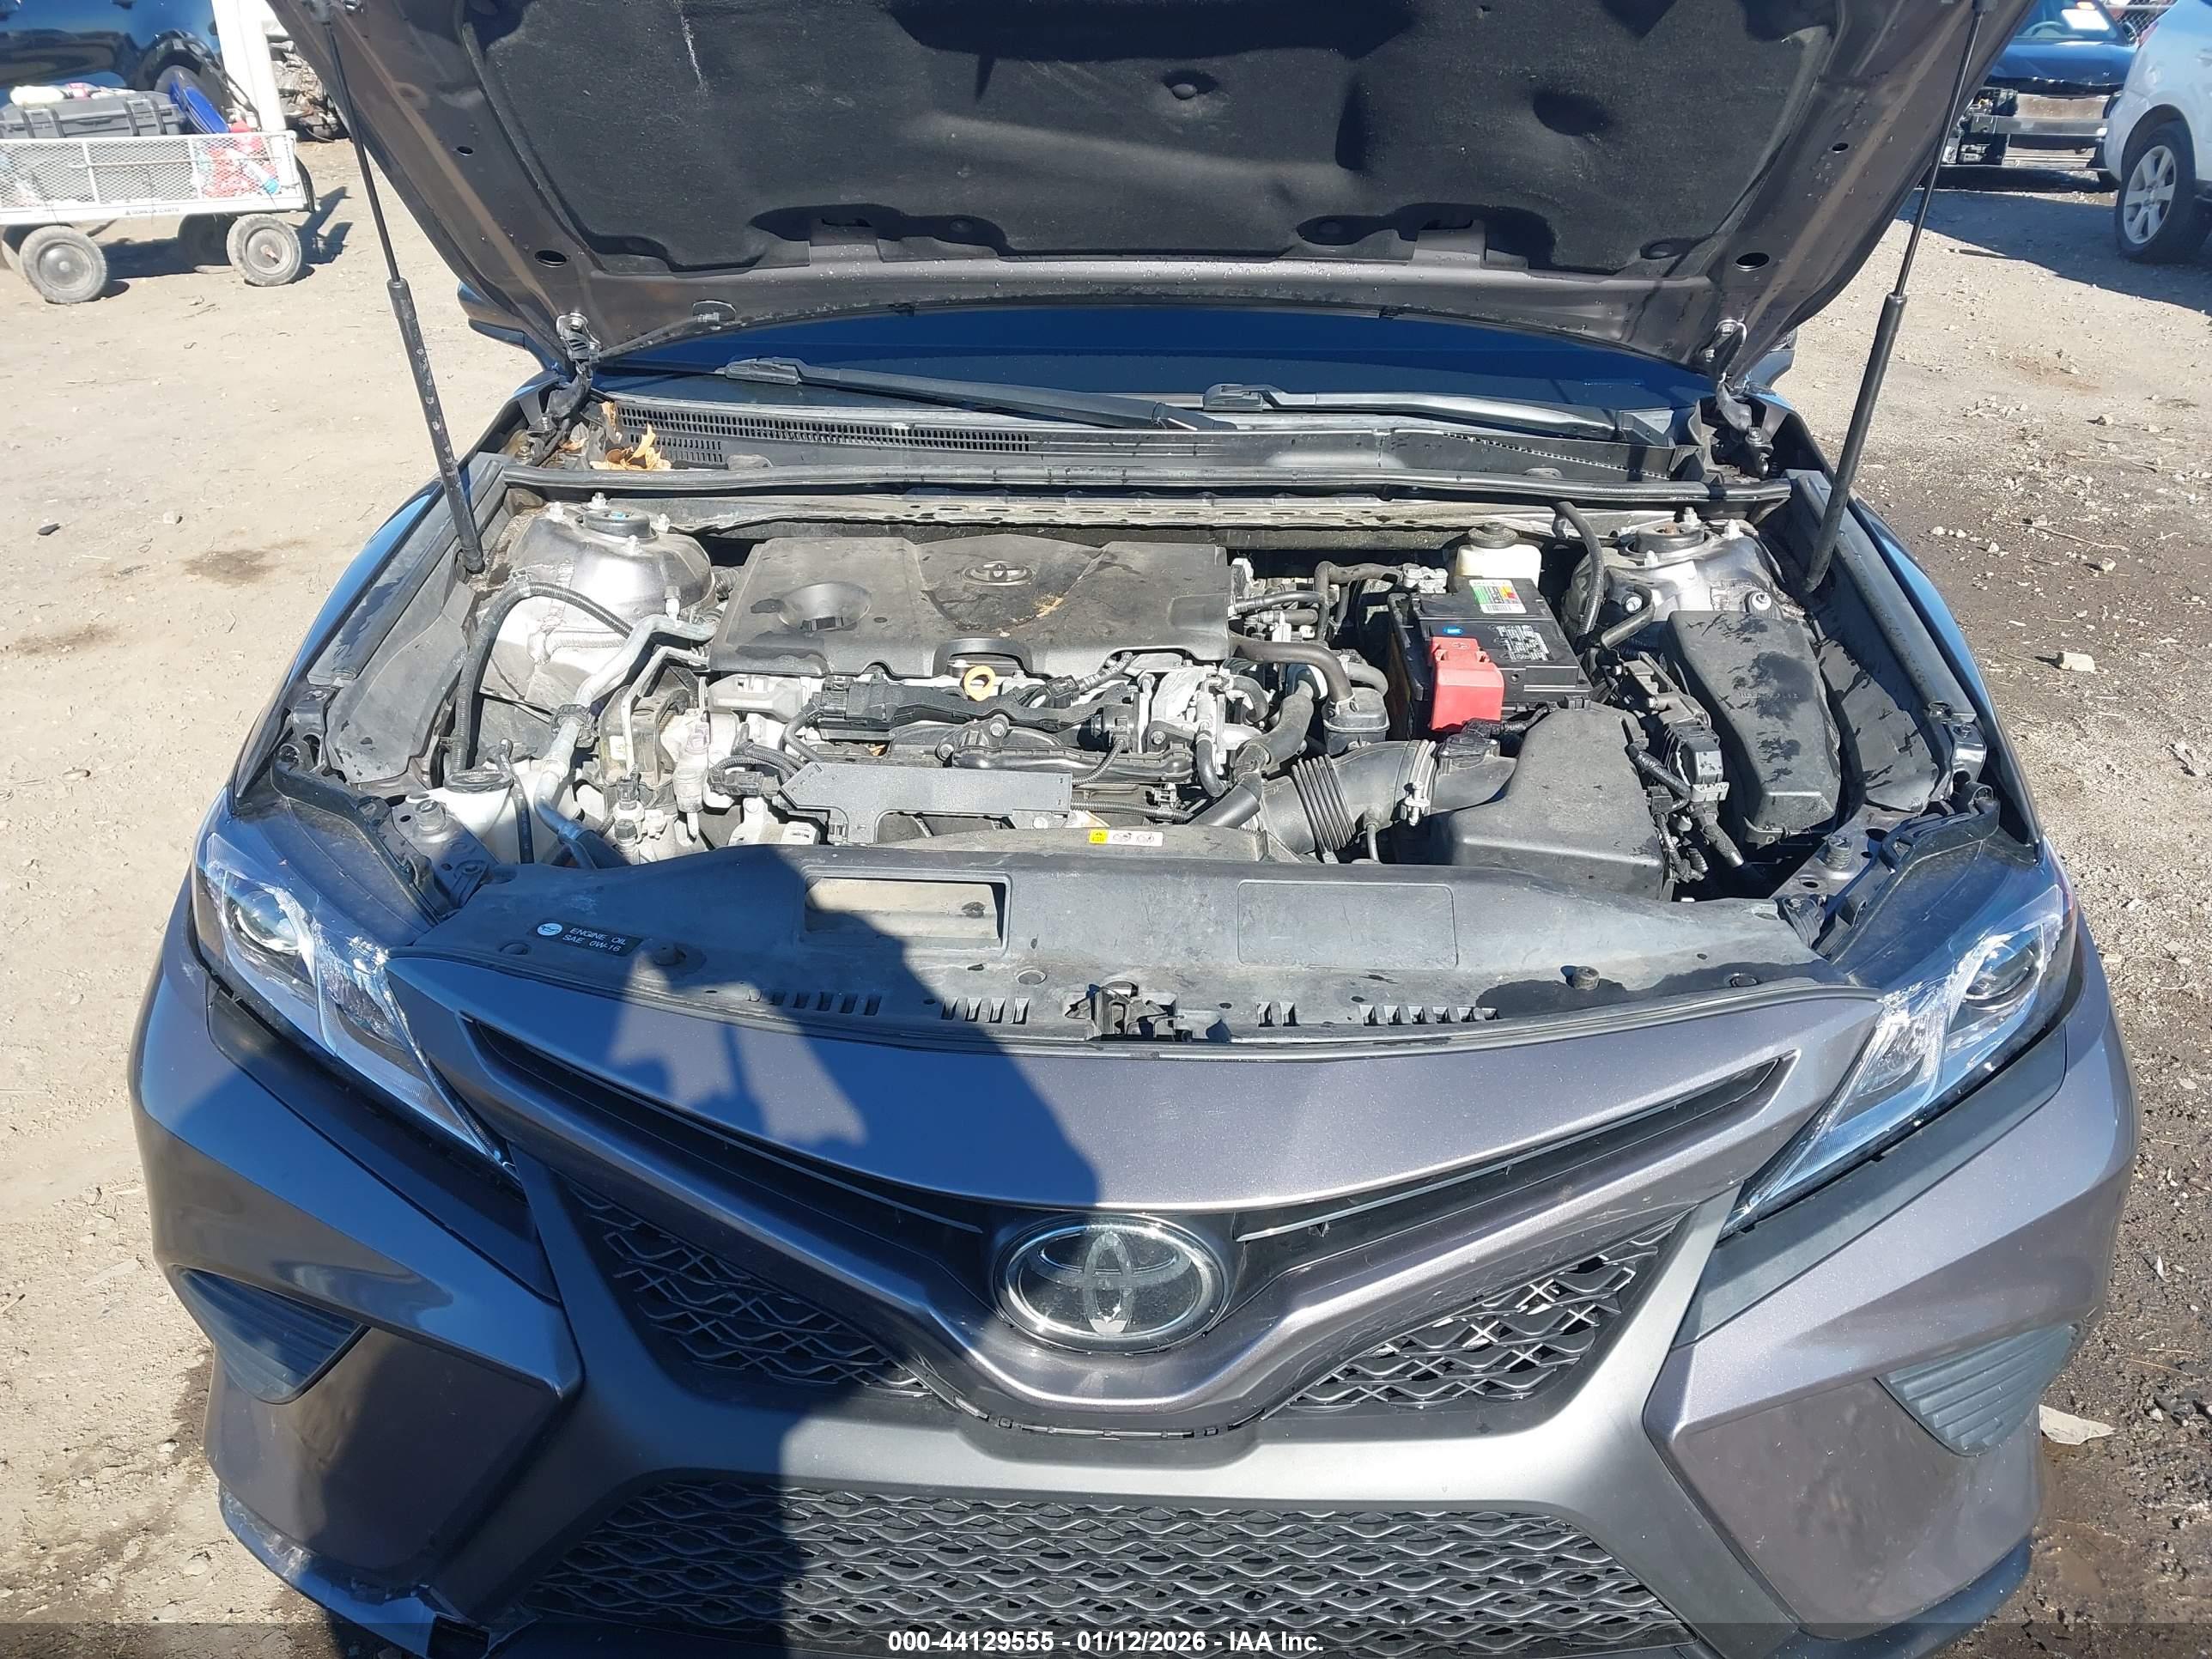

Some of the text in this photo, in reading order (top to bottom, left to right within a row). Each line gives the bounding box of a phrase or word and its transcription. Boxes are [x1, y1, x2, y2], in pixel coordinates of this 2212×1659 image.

[562, 934, 621, 952] SAE 0W-16
[570, 927, 626, 945] ENGINE OIL
